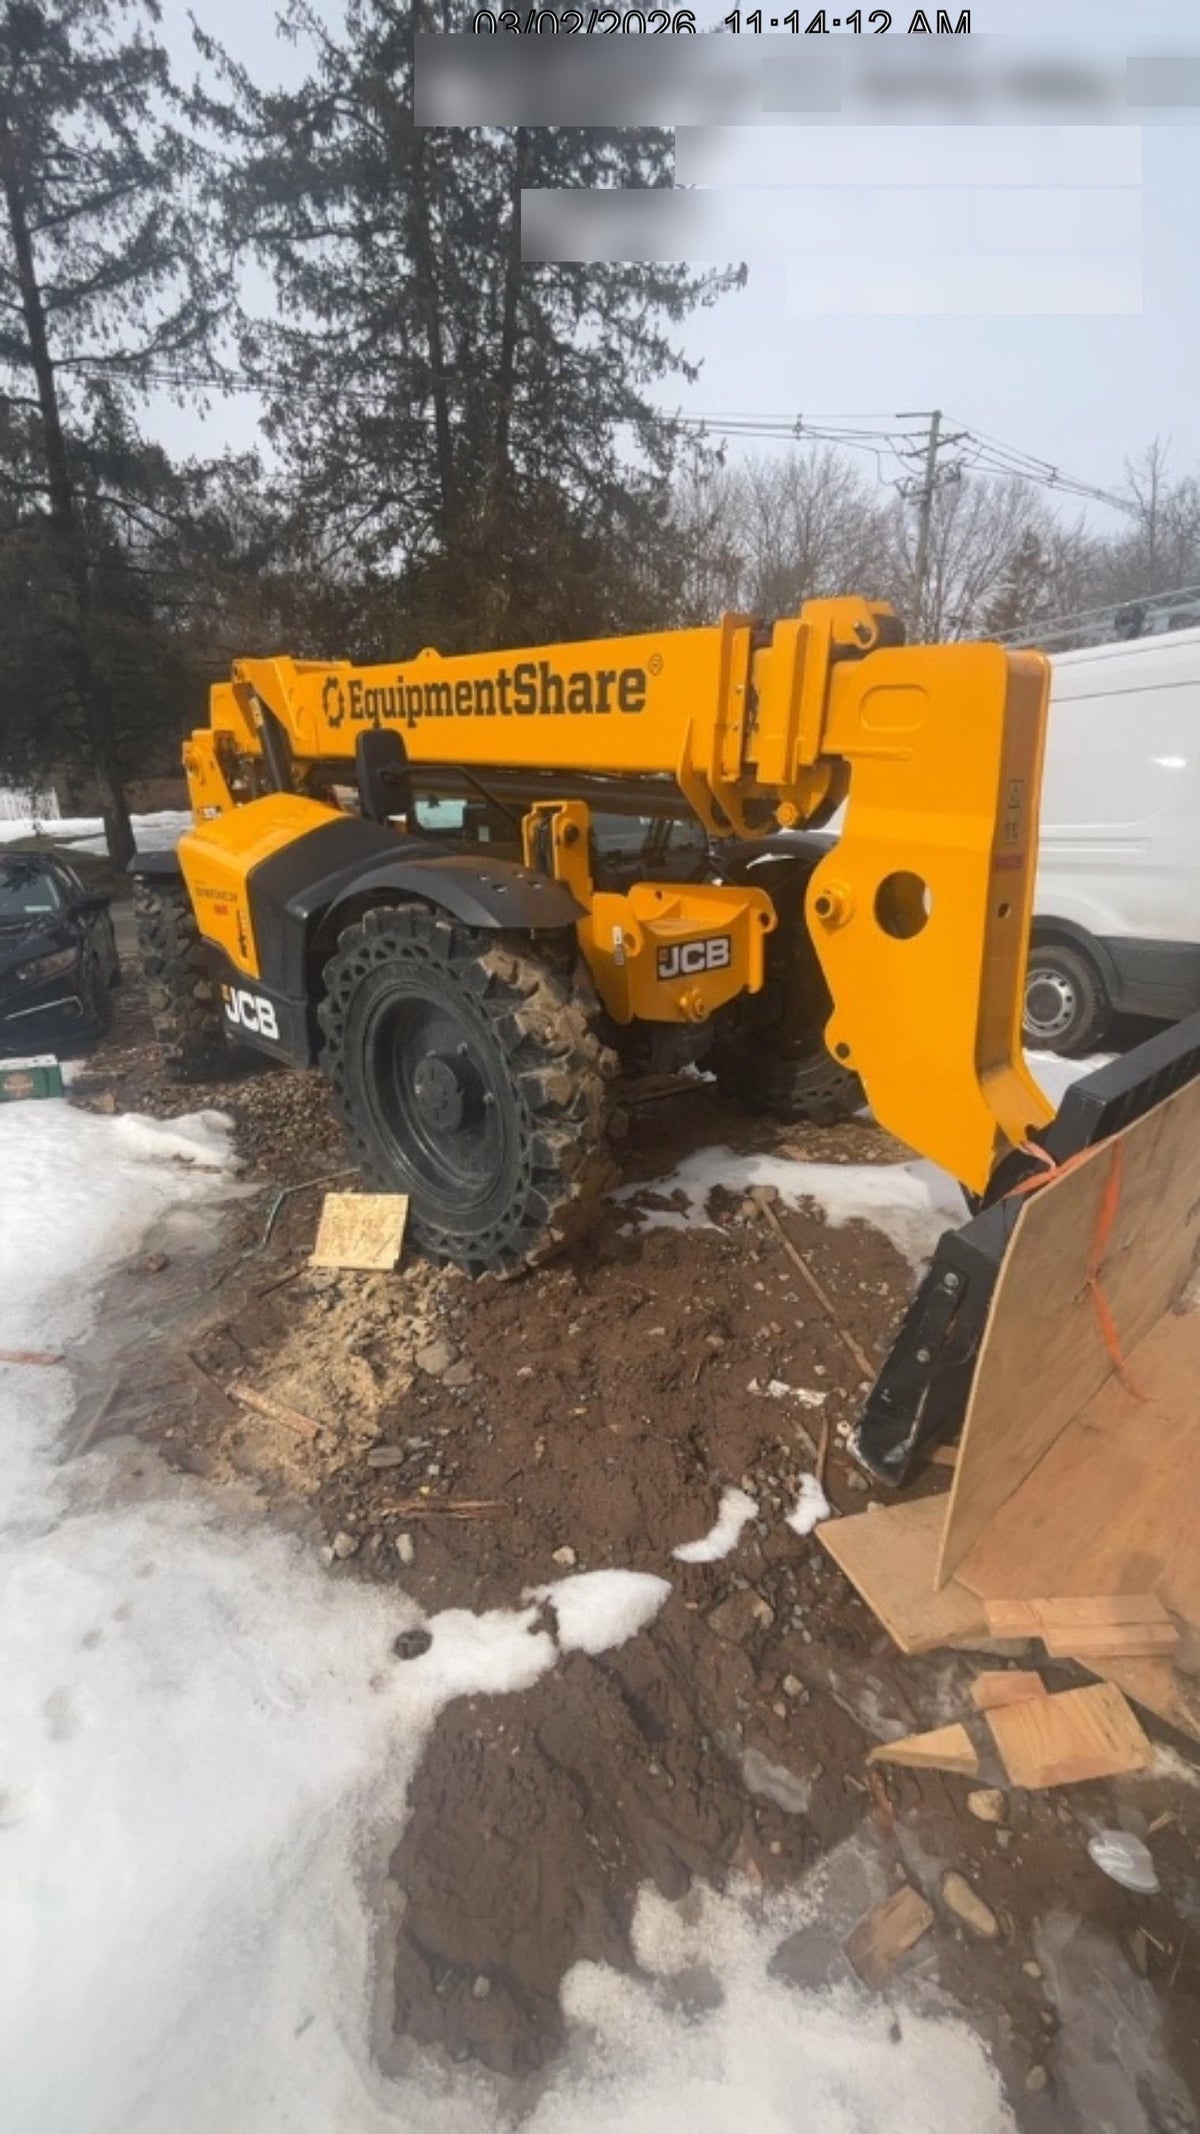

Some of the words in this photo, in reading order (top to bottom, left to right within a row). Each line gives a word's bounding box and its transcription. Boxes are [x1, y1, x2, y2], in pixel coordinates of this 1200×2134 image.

[348, 661, 646, 728] EquipmentShare
[658, 938, 729, 978] JCB
[222, 984, 279, 1040] JCB
